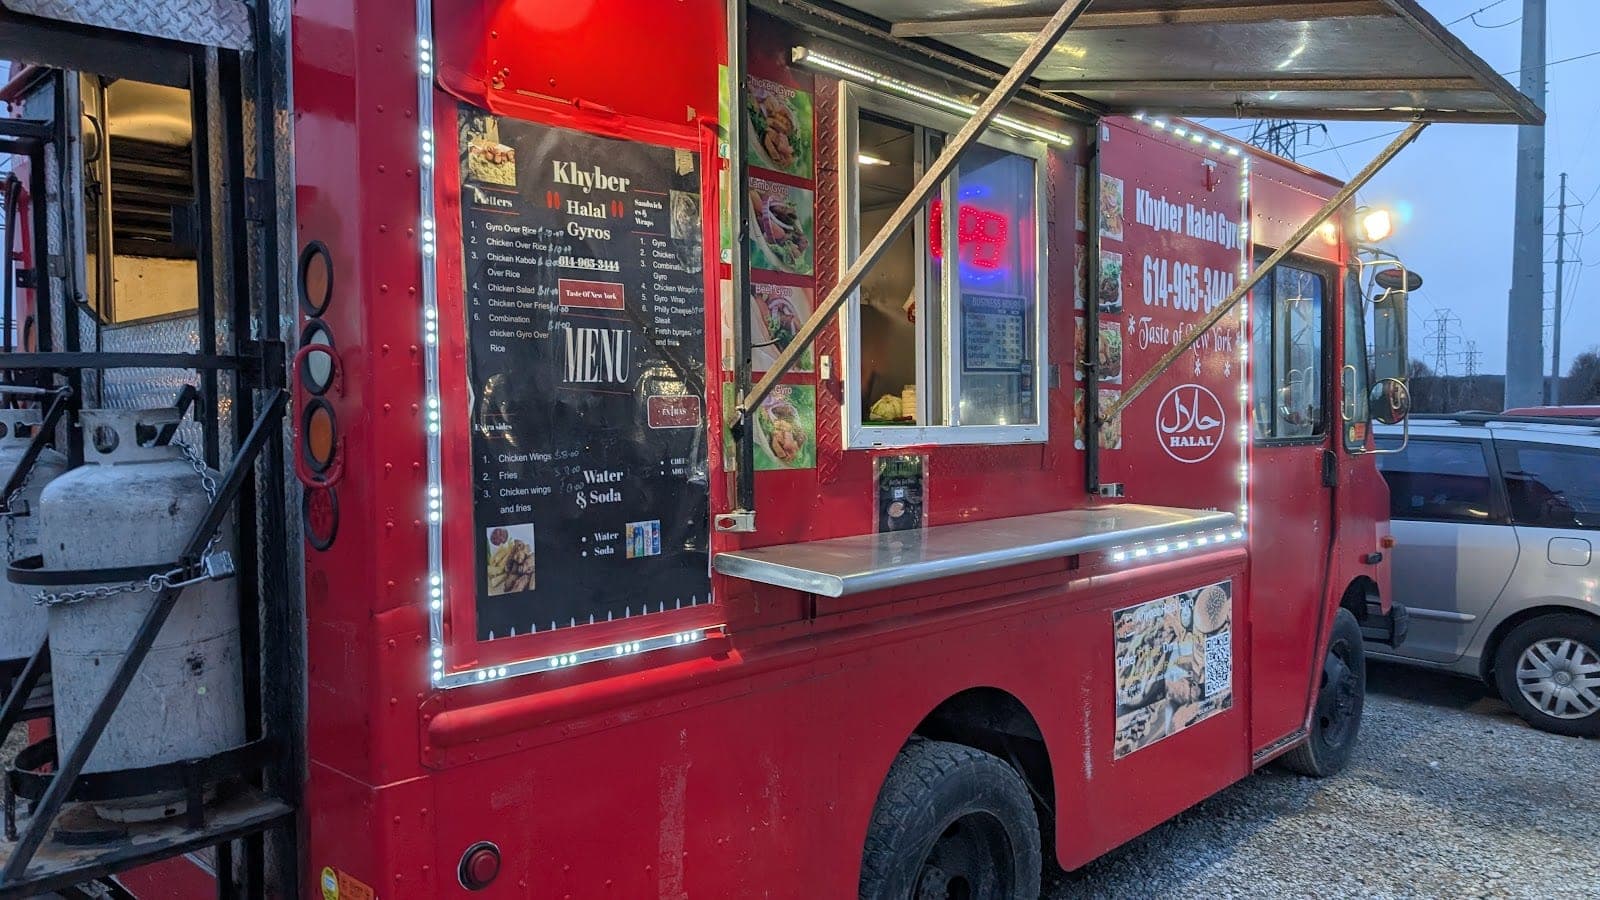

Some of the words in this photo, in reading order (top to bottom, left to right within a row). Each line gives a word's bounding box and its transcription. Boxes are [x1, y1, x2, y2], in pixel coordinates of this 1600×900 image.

[778, 84, 796, 98] Gyro
[552, 160, 630, 194] Khyber
[749, 177, 770, 191] Lamb
[474, 190, 513, 208] Ptters
[566, 199, 607, 219] Halal
[1136, 188, 1183, 234] Khyber
[1186, 203, 1217, 243] Halal
[485, 222, 503, 233] Gyro
[504, 224, 520, 233] Over
[522, 226, 537, 235] Rice
[567, 222, 611, 241] Gyros
[486, 237, 513, 247] Chicken
[514, 240, 531, 250] Over
[532, 242, 547, 251] Rice
[652, 238, 667, 248] Gyro
[487, 252, 514, 263] Chicken
[515, 255, 537, 265] Kabob
[652, 250, 676, 260] Chicken
[487, 268, 504, 277] Over
[505, 269, 520, 279] Rice
[653, 272, 668, 281] Gyro
[487, 283, 515, 293] Chicken
[516, 285, 535, 294] Salad
[653, 283, 677, 292] Chicken
[1143, 254, 1234, 316] 614-965-3444
[565, 289, 581, 298] Taste
[591, 290, 602, 299] New
[603, 291, 617, 300] York
[653, 294, 668, 303] Gyro
[670, 295, 686, 304] Wrap
[488, 298, 515, 308] Chicken
[516, 300, 533, 309] Over
[534, 301, 550, 310] Fries
[488, 313, 531, 324] Combination
[489, 329, 515, 338] chicken
[516, 330, 533, 340] Gyro
[533, 331, 549, 339] Over
[1138, 317, 1169, 350] Taste
[1172, 321, 1184, 346] of
[1212, 326, 1232, 353] York
[490, 344, 506, 353] Rice
[563, 328, 632, 383] MENU
[774, 384, 793, 396] Gyro
[1160, 388, 1221, 434] حلال
[1169, 435, 1214, 447] HALAL
[498, 454, 528, 463] Chicken
[529, 453, 552, 462] Wings
[499, 471, 518, 480] Fries
[583, 469, 624, 484] Water
[499, 488, 529, 497] Chicken
[530, 485, 552, 496] wings
[589, 488, 621, 504] Soda
[500, 504, 514, 514] and
[515, 503, 532, 512] fries
[594, 532, 619, 542] Water
[594, 545, 614, 556] Soda
